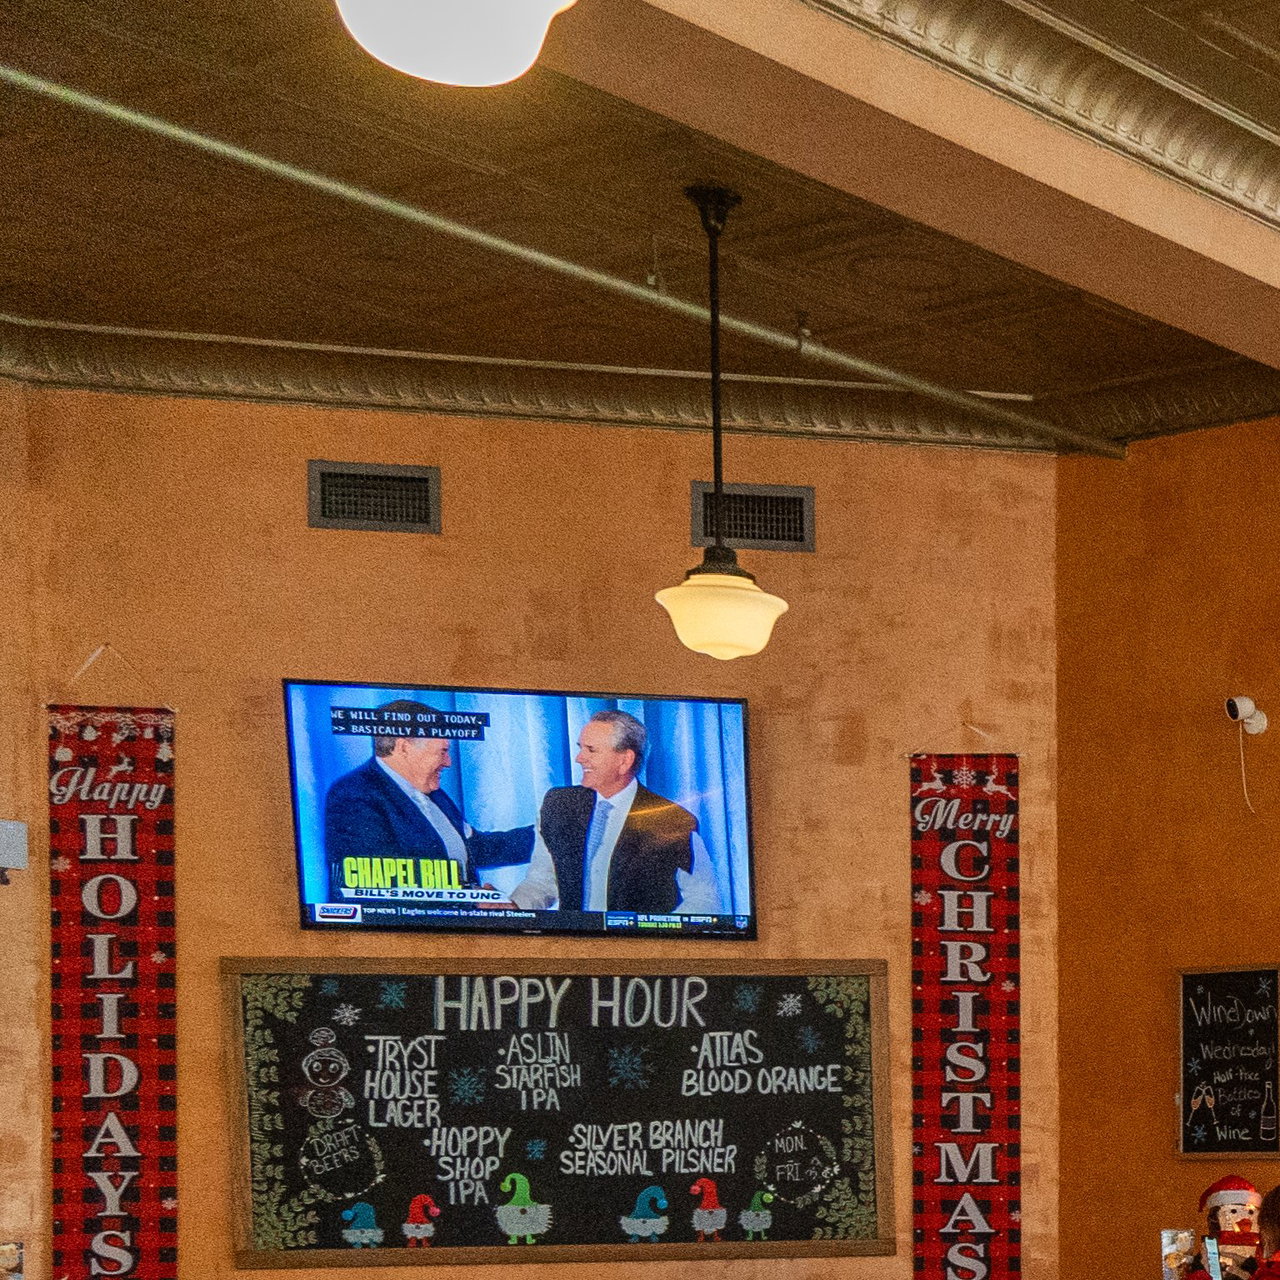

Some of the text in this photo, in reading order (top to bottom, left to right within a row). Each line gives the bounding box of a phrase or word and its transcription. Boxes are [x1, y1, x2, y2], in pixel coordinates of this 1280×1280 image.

[331, 710, 344, 720] WE
[350, 711, 378, 721] WILL
[384, 712, 411, 722] FIND
[416, 713, 437, 723] OUT
[351, 725, 411, 736] BASICALLY
[418, 728, 426, 736] A
[431, 728, 478, 738] PLAYOFF
[49, 767, 167, 810] Happy
[914, 797, 1014, 839] Merry
[343, 856, 463, 890] CHAPEL BILL
[354, 889, 501, 901] BILL'S MOVE TO UNC
[506, 910, 536, 919] Steelers
[434, 976, 708, 1031] HAPPY HOUR
[79, 814, 140, 1276] HOLIDAYS
[364, 1035, 447, 1070] TRYST
[506, 1032, 571, 1066] ASLIN
[697, 1029, 764, 1070] ATLAS
[364, 1070, 439, 1100] HOUSE
[495, 1063, 581, 1090] STARFISH
[681, 1064, 843, 1097] BLOOD ORANGE
[369, 1100, 441, 1128] LAGER
[520, 1088, 560, 1112] IPA
[1230, 1104, 1242, 1117] of
[310, 1124, 359, 1156] DRAFT
[430, 1126, 512, 1158] HOPPY
[573, 1119, 724, 1151] SILVER BRANCH
[1216, 1125, 1253, 1141] Wine
[309, 1146, 360, 1174] BEERS
[437, 1156, 500, 1182] SHOP
[559, 1144, 737, 1177] SEASONAL PILSNER
[449, 1181, 489, 1205] IPA
